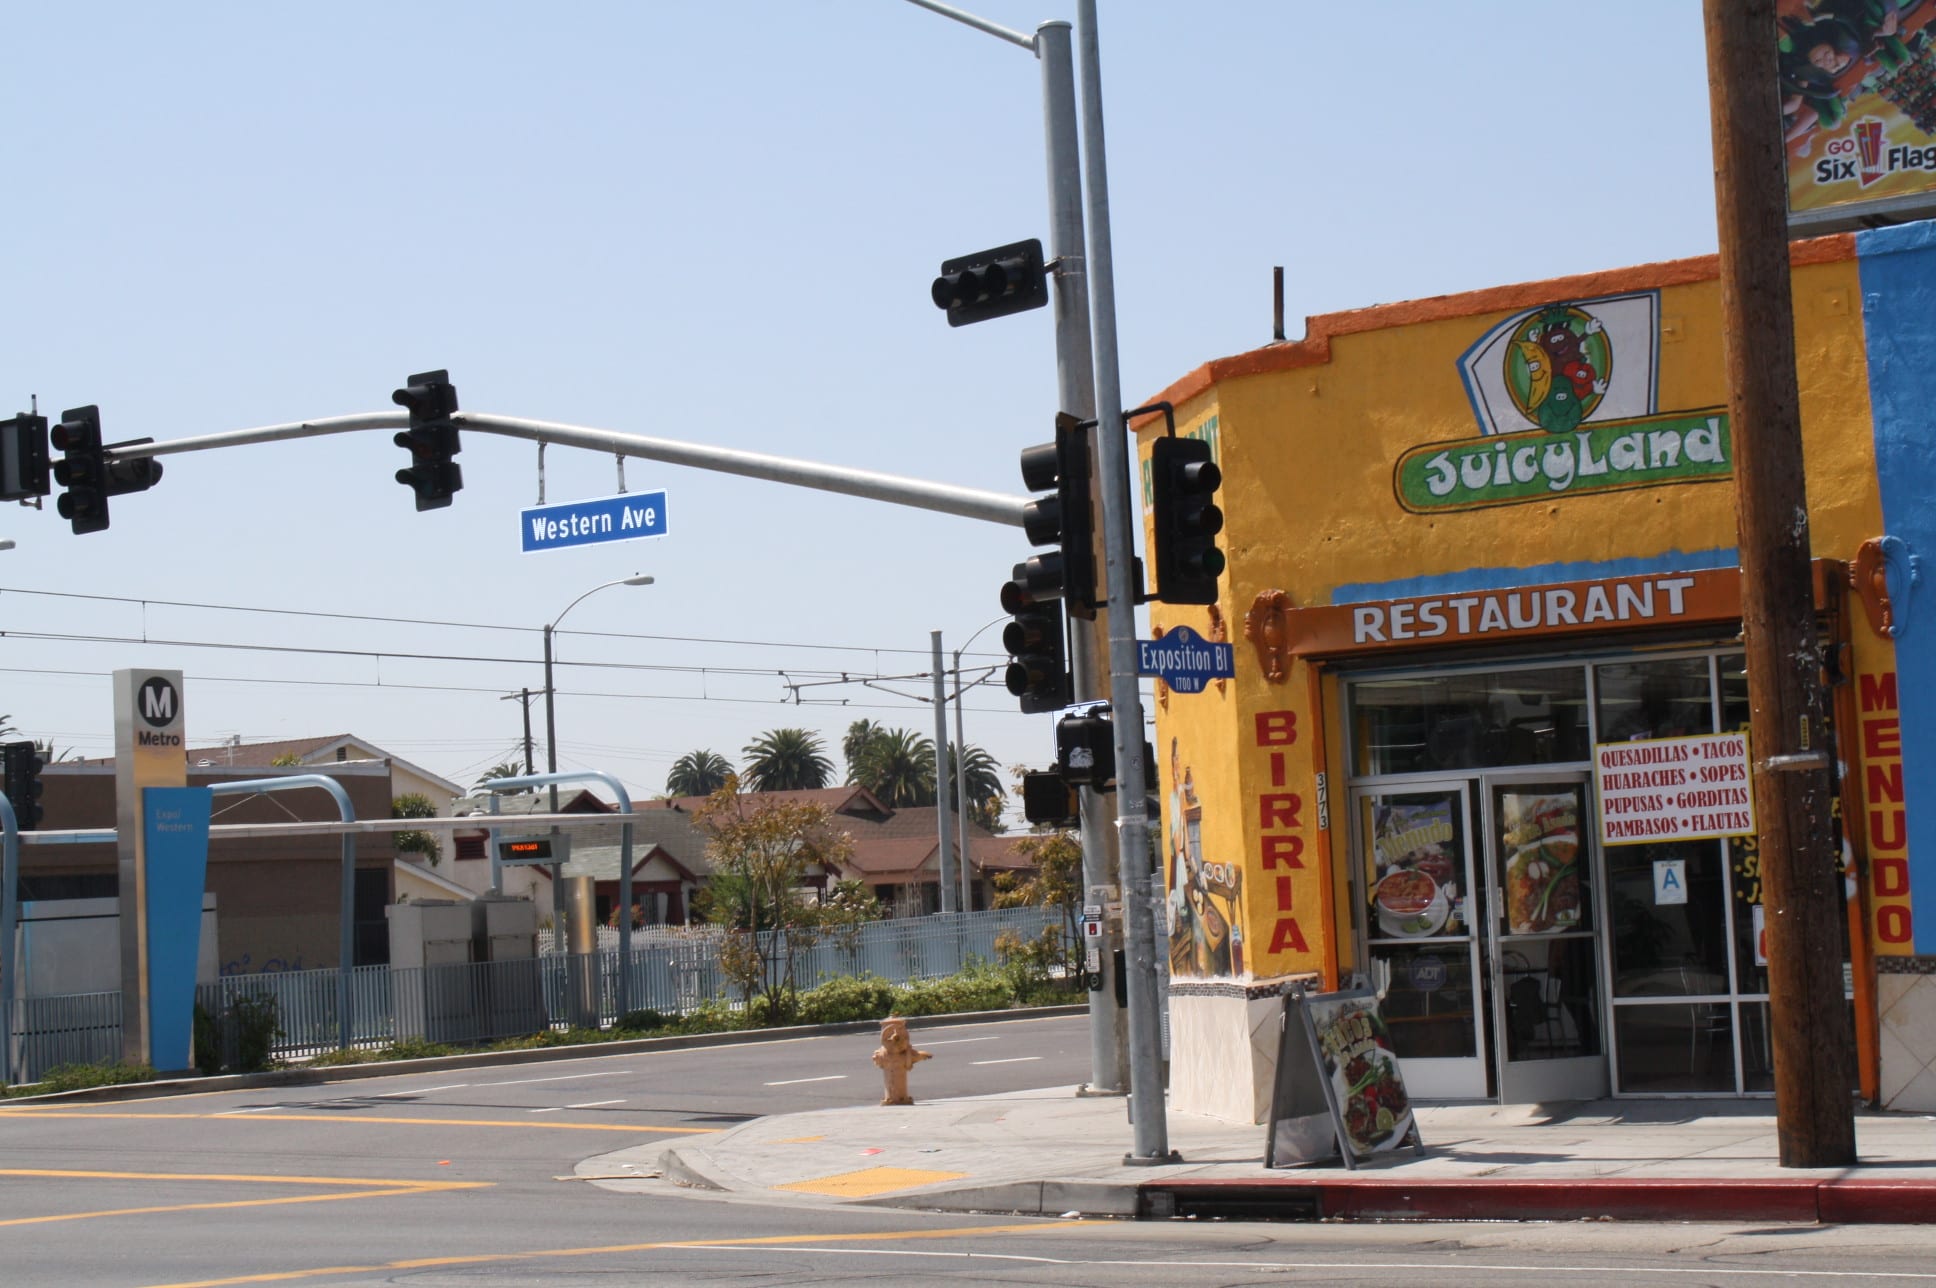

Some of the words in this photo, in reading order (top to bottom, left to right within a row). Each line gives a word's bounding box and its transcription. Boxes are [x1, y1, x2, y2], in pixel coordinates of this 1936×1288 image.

[1828, 139, 1855, 155] GO
[1816, 159, 1857, 182] Six
[532, 513, 612, 542] Western
[621, 505, 656, 530] Ave
[1353, 577, 1695, 644] RESTAURANT
[1141, 643, 1211, 676] Exposition
[1215, 645, 1228, 672] Bl
[1175, 677, 1192, 691] 1700
[1193, 677, 1200, 691] W
[145, 686, 173, 719] M
[138, 731, 181, 747] Metro
[1601, 744, 1689, 769] QUESADILLAS
[1701, 739, 1744, 760] TACOS
[1603, 768, 1686, 791] HUARACHES
[1701, 763, 1746, 784] SOPES
[1317, 773, 1328, 829] 3773
[1605, 794, 1664, 815] PUPUSAS
[1676, 787, 1748, 809] GORDITAS
[1859, 672, 1913, 944] MENUDO
[1254, 709, 1311, 954] BIRRIA
[1606, 816, 1679, 838] PAMBASOS
[1691, 811, 1750, 832] FLAUTAS
[1662, 868, 1681, 889] A
[1415, 966, 1441, 981] ADT
